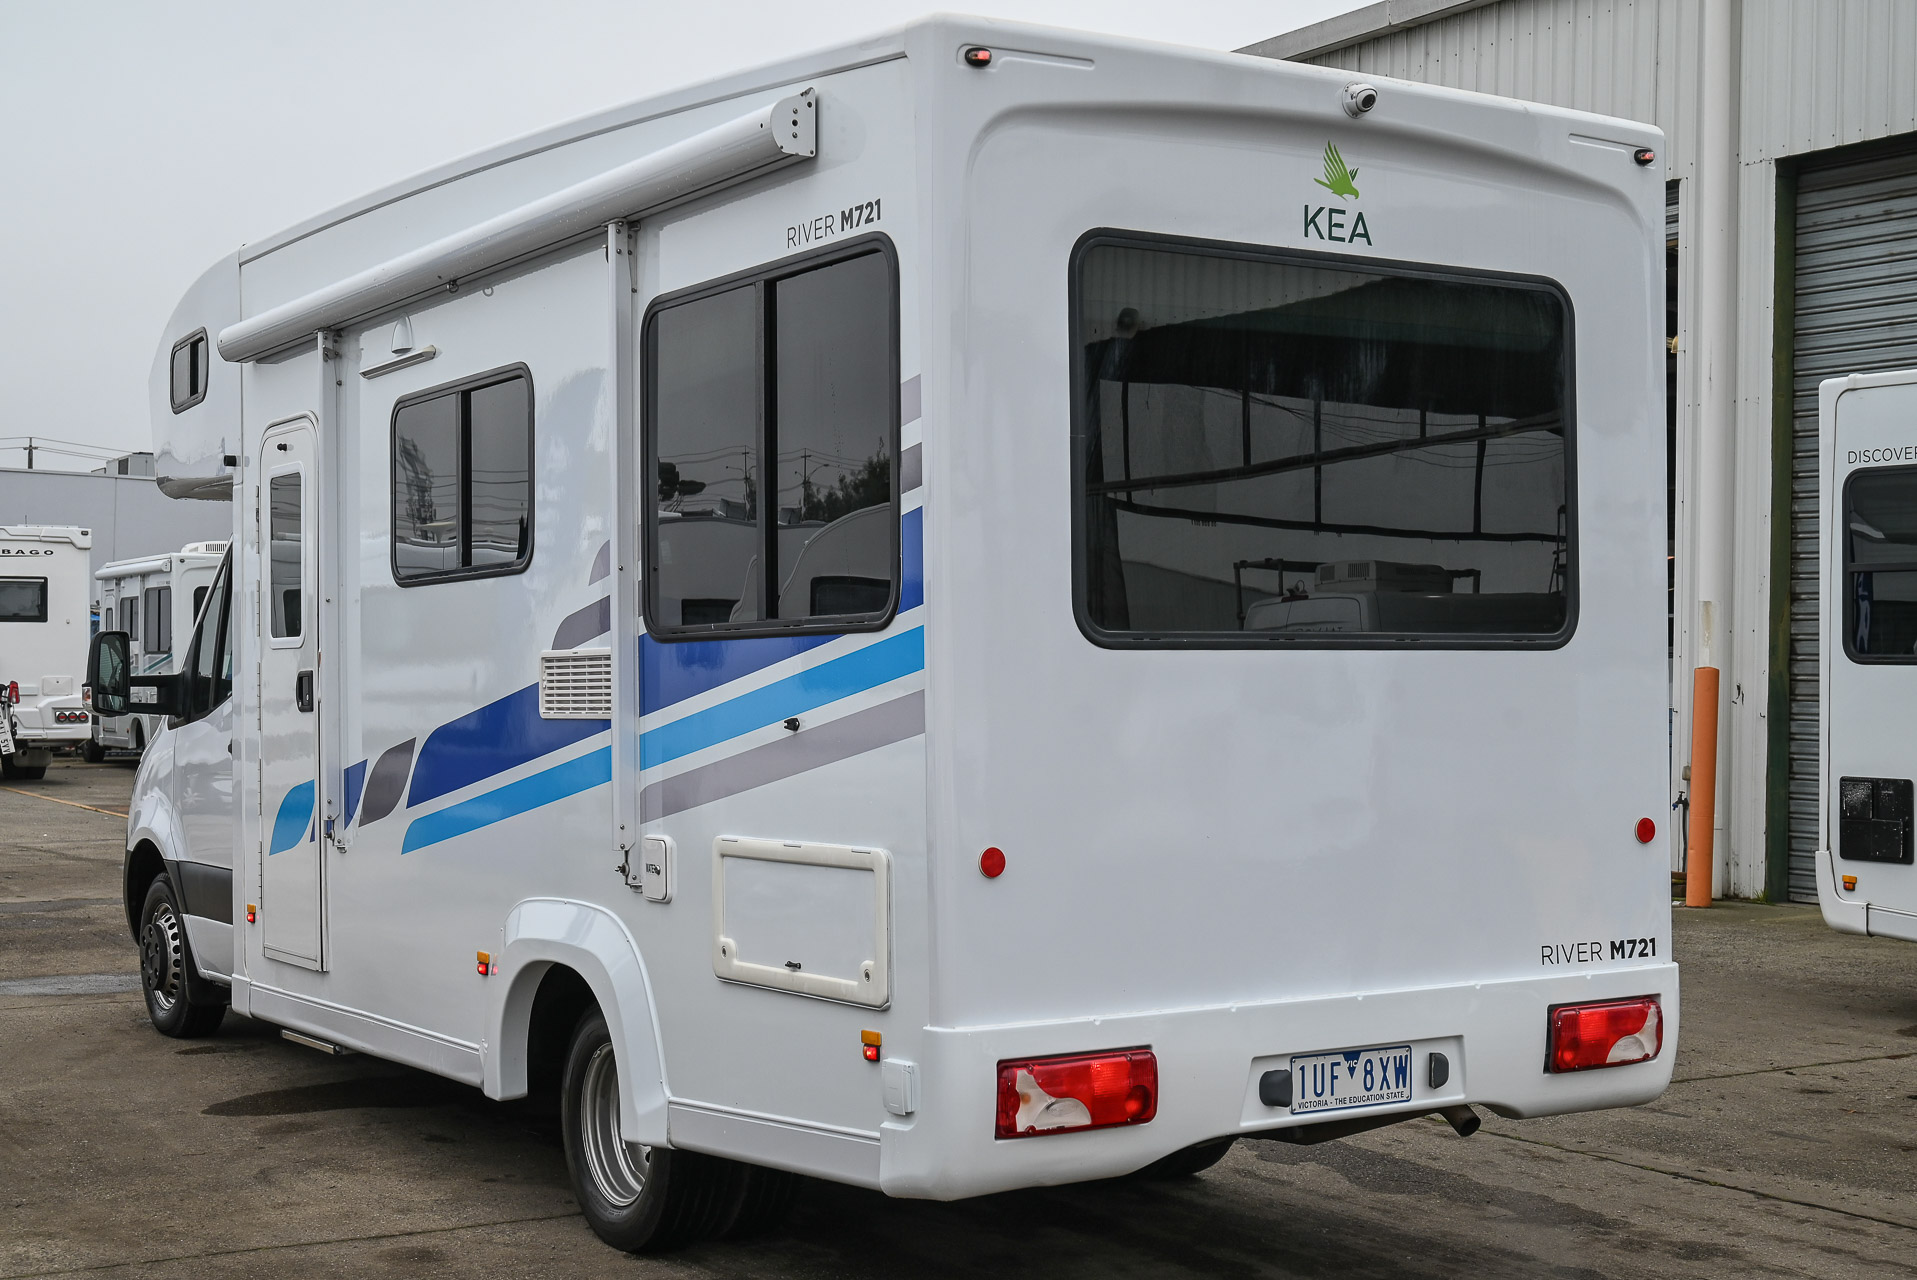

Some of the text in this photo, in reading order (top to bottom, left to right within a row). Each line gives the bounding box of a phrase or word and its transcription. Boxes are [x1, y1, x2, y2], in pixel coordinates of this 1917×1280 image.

[787, 198, 881, 249] RIVER M721
[1304, 204, 1373, 247] KEA
[1541, 937, 1656, 965] RIVER M721
[1299, 1054, 1409, 1100] 1UF 8XW
[1297, 1100, 1329, 1109] VICTORIA
[1348, 1093, 1385, 1104] EDUCATION
[1386, 1091, 1405, 1100] STATE
